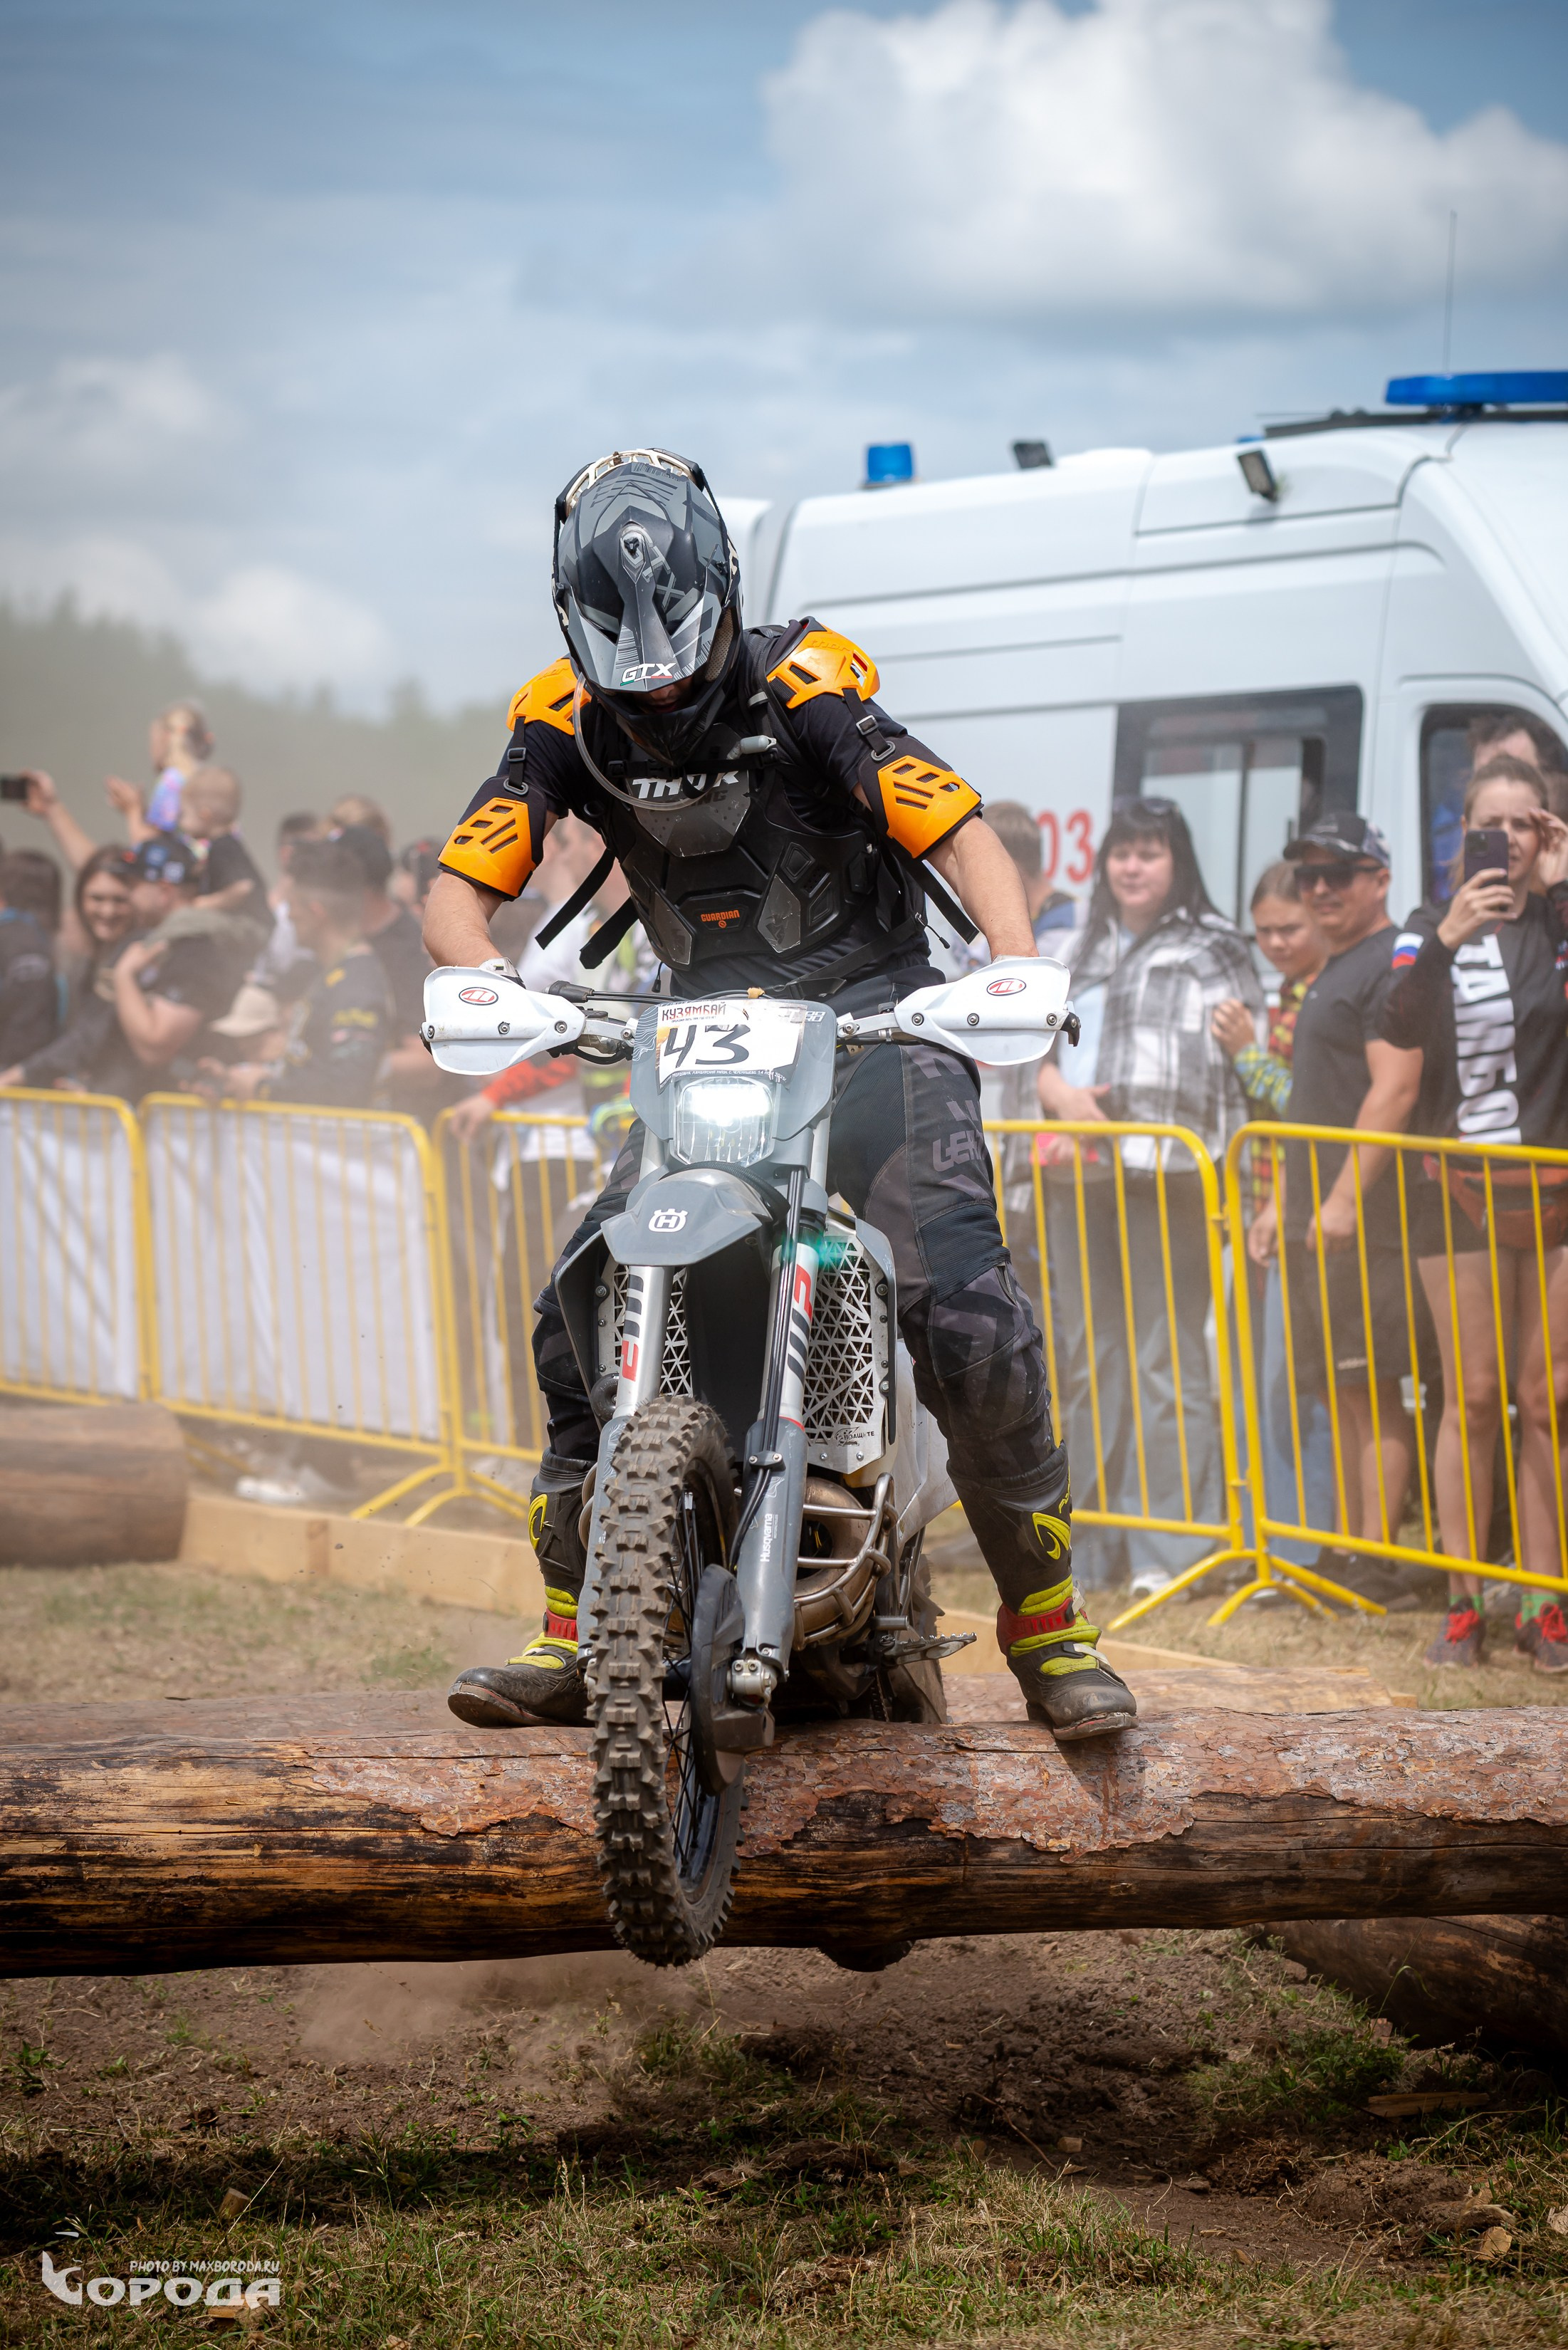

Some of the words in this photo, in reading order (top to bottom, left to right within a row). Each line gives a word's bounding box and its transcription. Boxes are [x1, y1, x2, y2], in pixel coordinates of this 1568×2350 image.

[621, 662, 676, 683] GTX
[701, 909, 740, 922] GUARDIAN
[662, 1001, 726, 1021] КУЗЯМБАЙ
[664, 1024, 751, 1068] 43
[760, 1513, 773, 1562] Husqvarna
